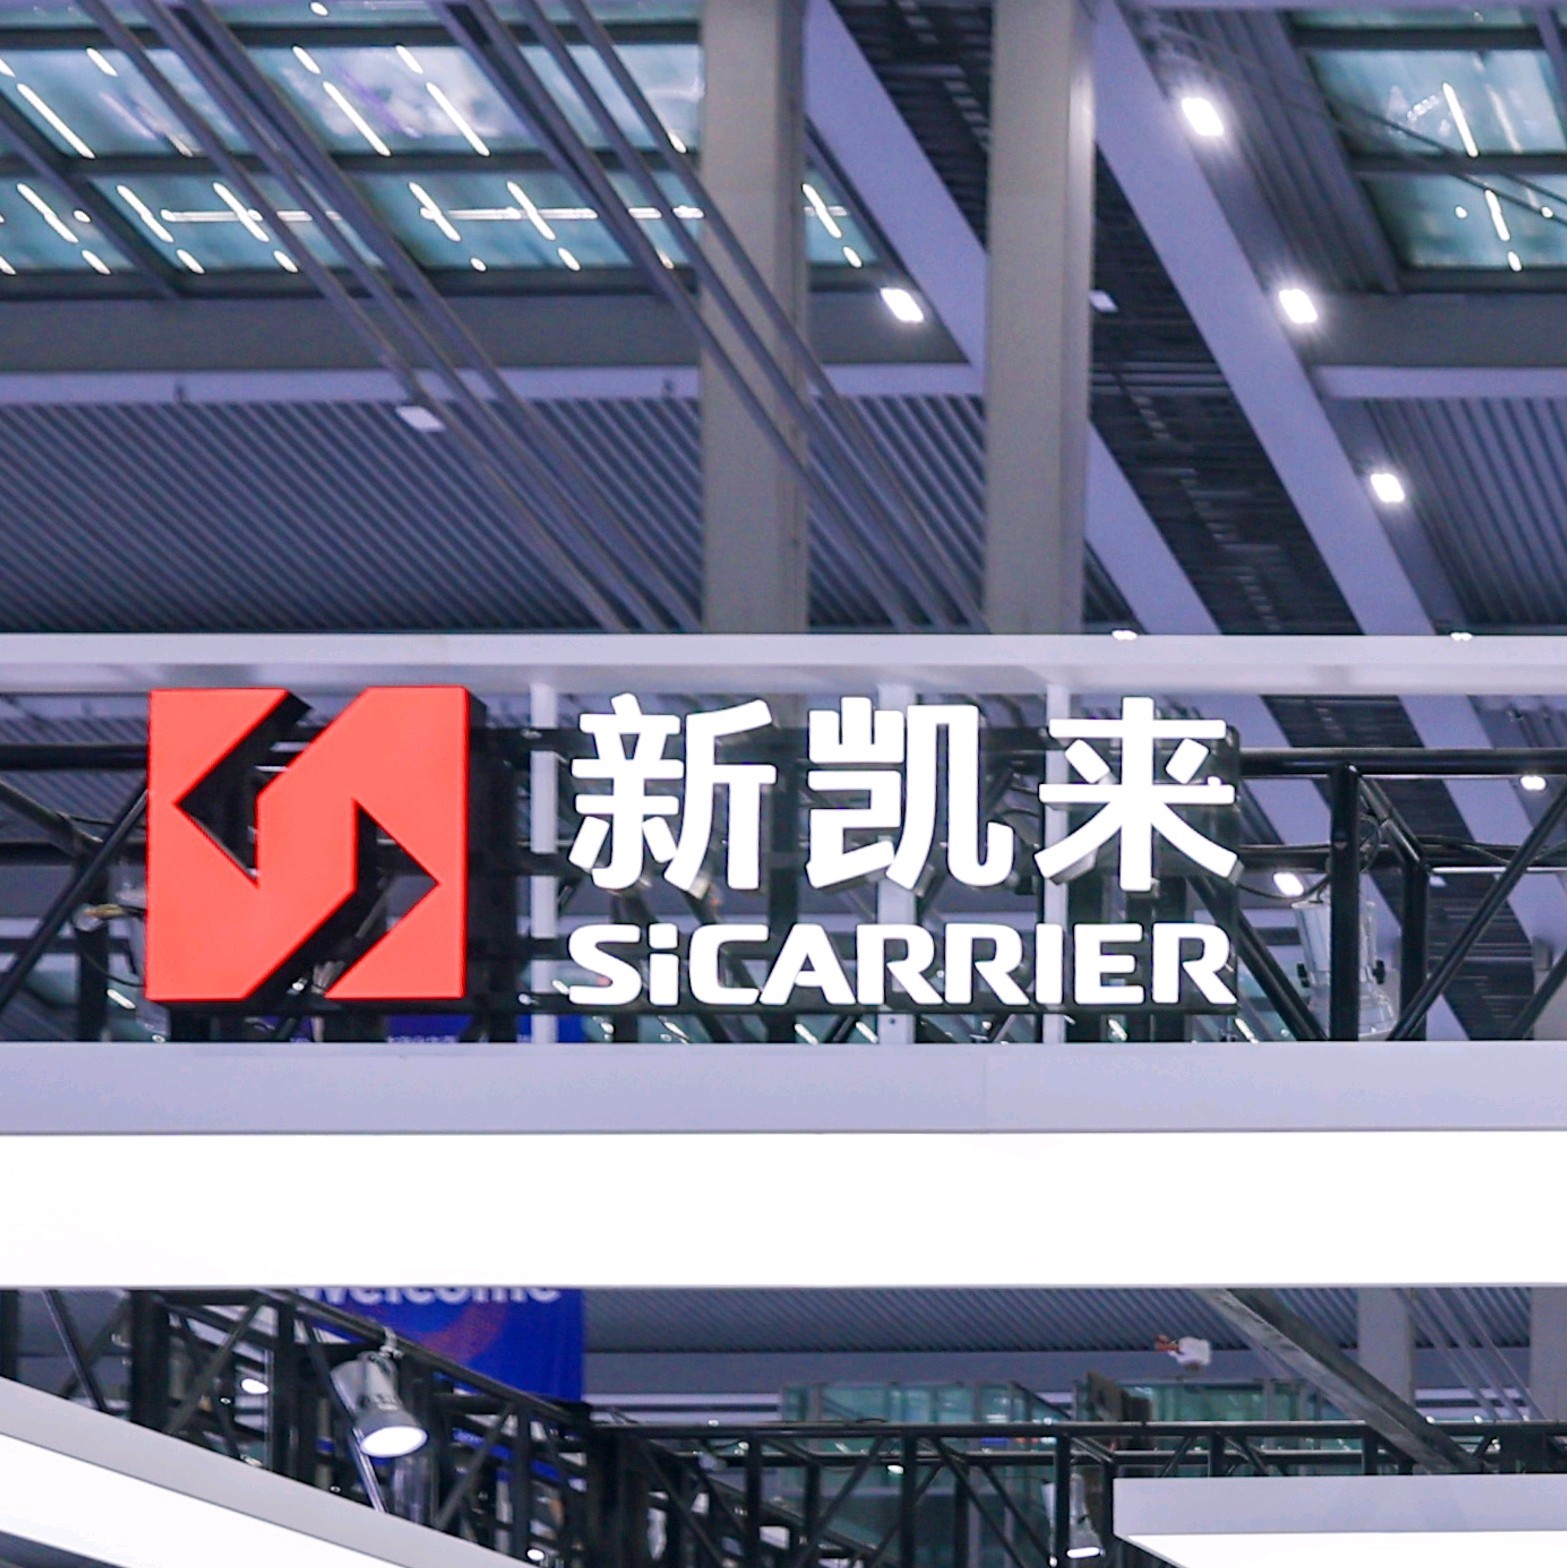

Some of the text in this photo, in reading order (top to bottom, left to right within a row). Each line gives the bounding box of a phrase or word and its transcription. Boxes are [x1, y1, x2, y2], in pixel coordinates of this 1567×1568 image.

[569, 693, 1238, 893] 新凯来
[567, 923, 1236, 1006] SiCARRIER
